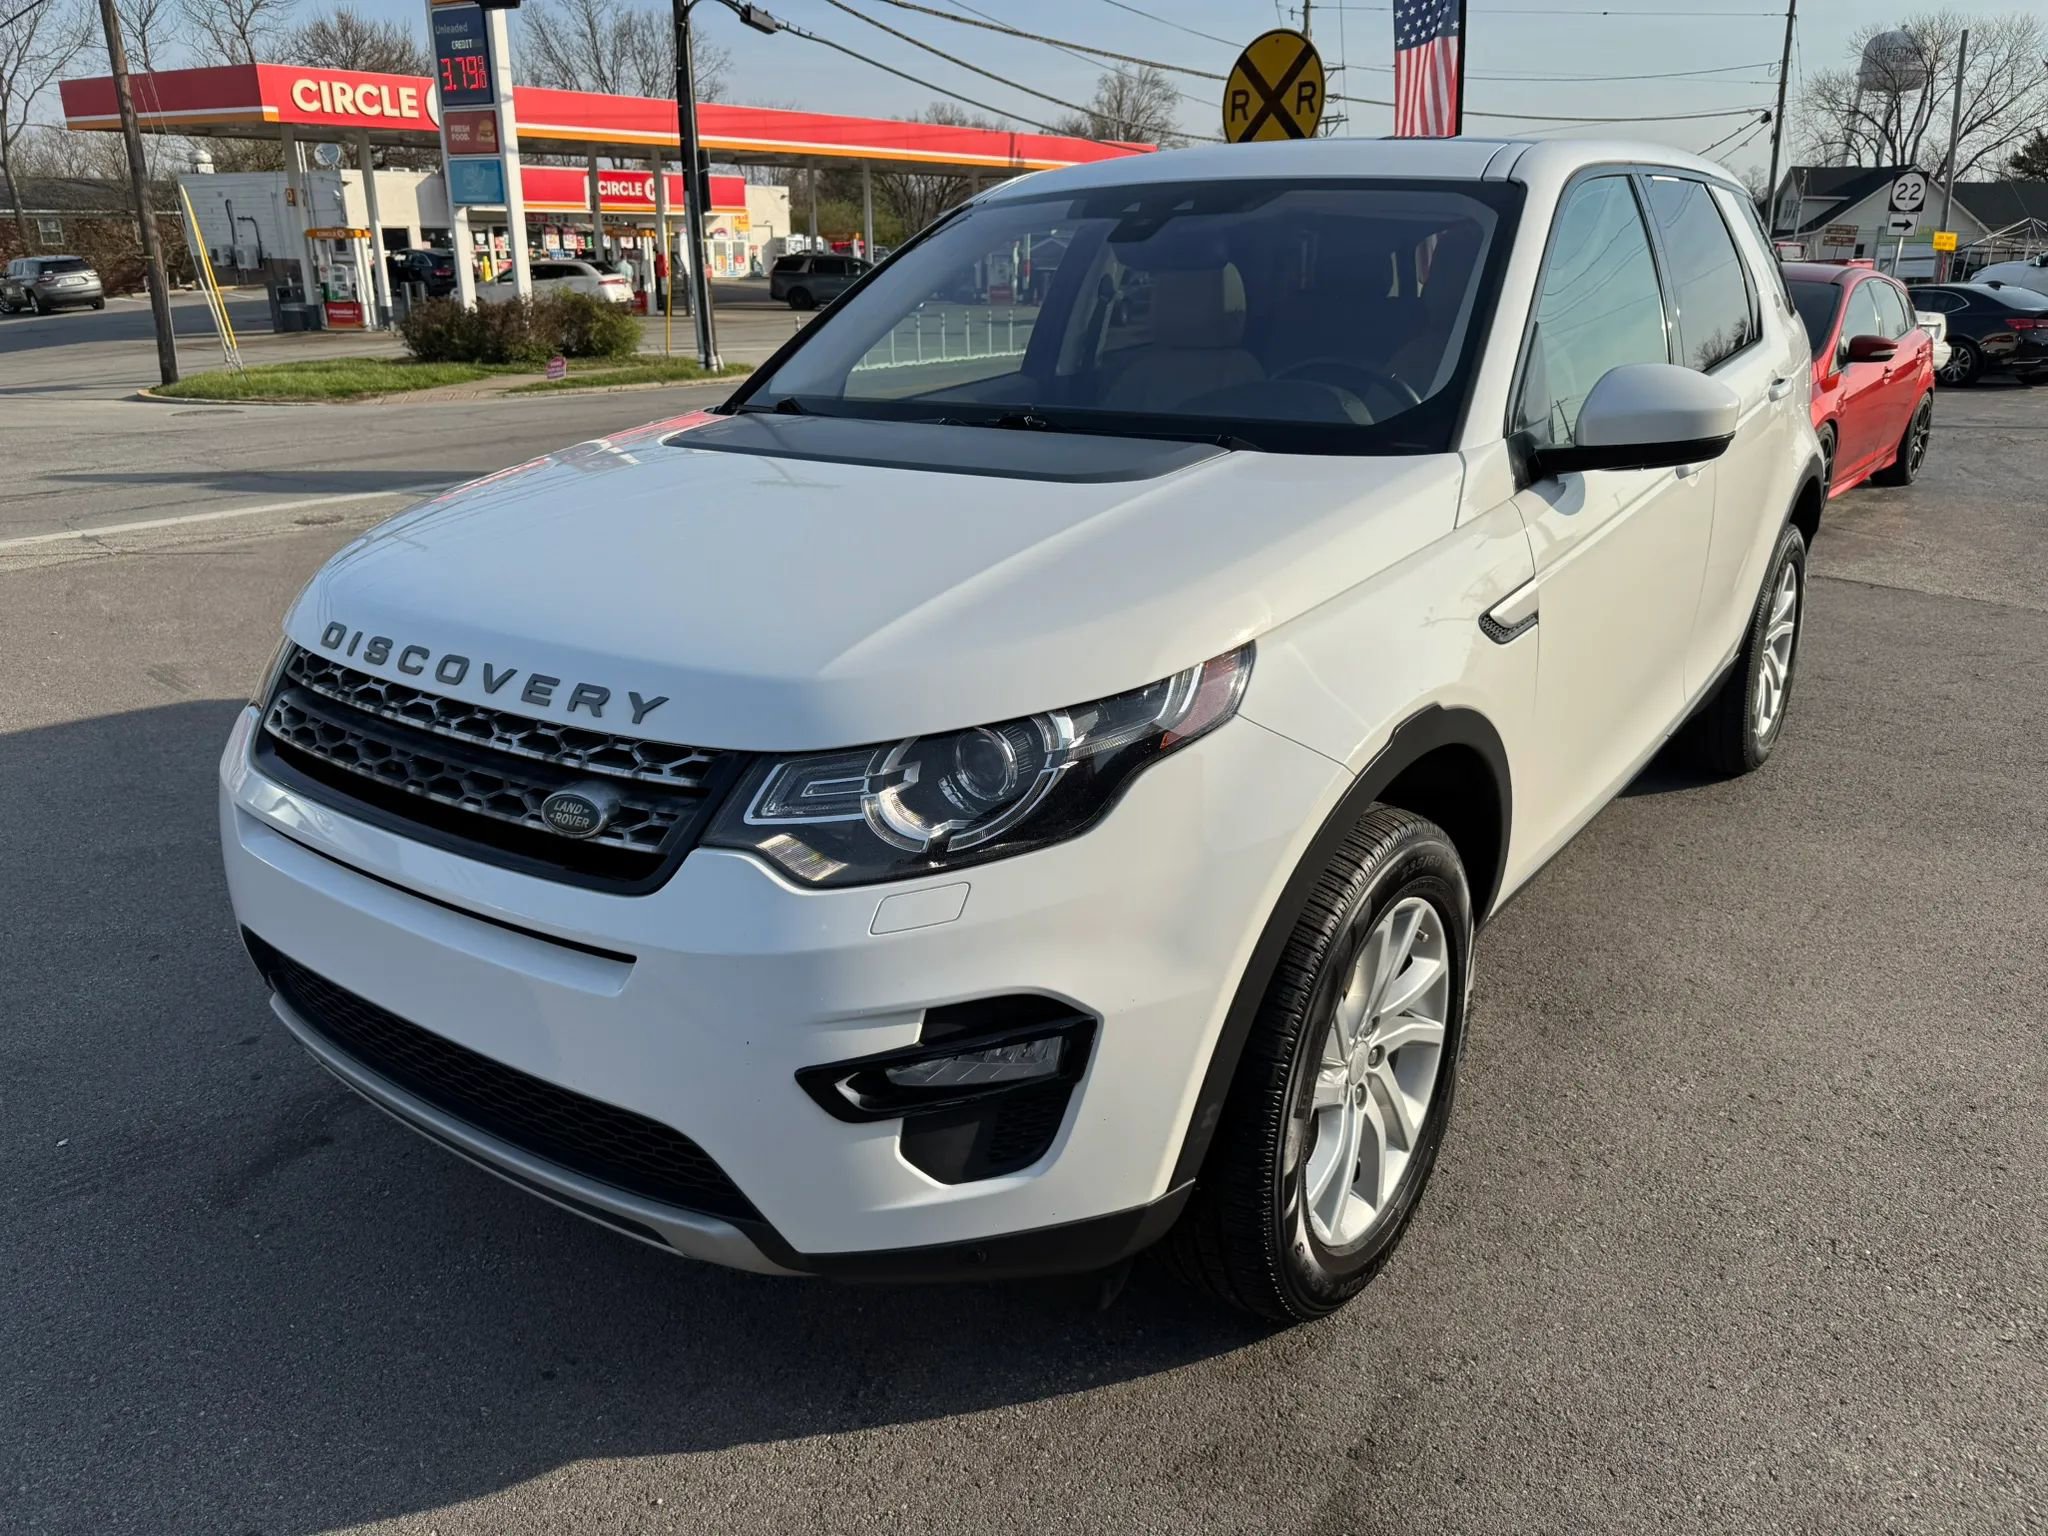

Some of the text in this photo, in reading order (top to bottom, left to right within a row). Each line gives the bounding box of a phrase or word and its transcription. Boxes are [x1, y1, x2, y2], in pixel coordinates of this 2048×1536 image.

[435, 22, 468, 34] Unleaded
[452, 39, 472, 49] CREDIT
[292, 79, 419, 118] CIRCLE
[1231, 81, 1316, 122] R R
[598, 180, 643, 196] CIRCLE
[1896, 183, 1921, 201] 22
[320, 621, 670, 725] DISCOVERY
[553, 800, 583, 814] LAND
[554, 812, 590, 828] ROVER
